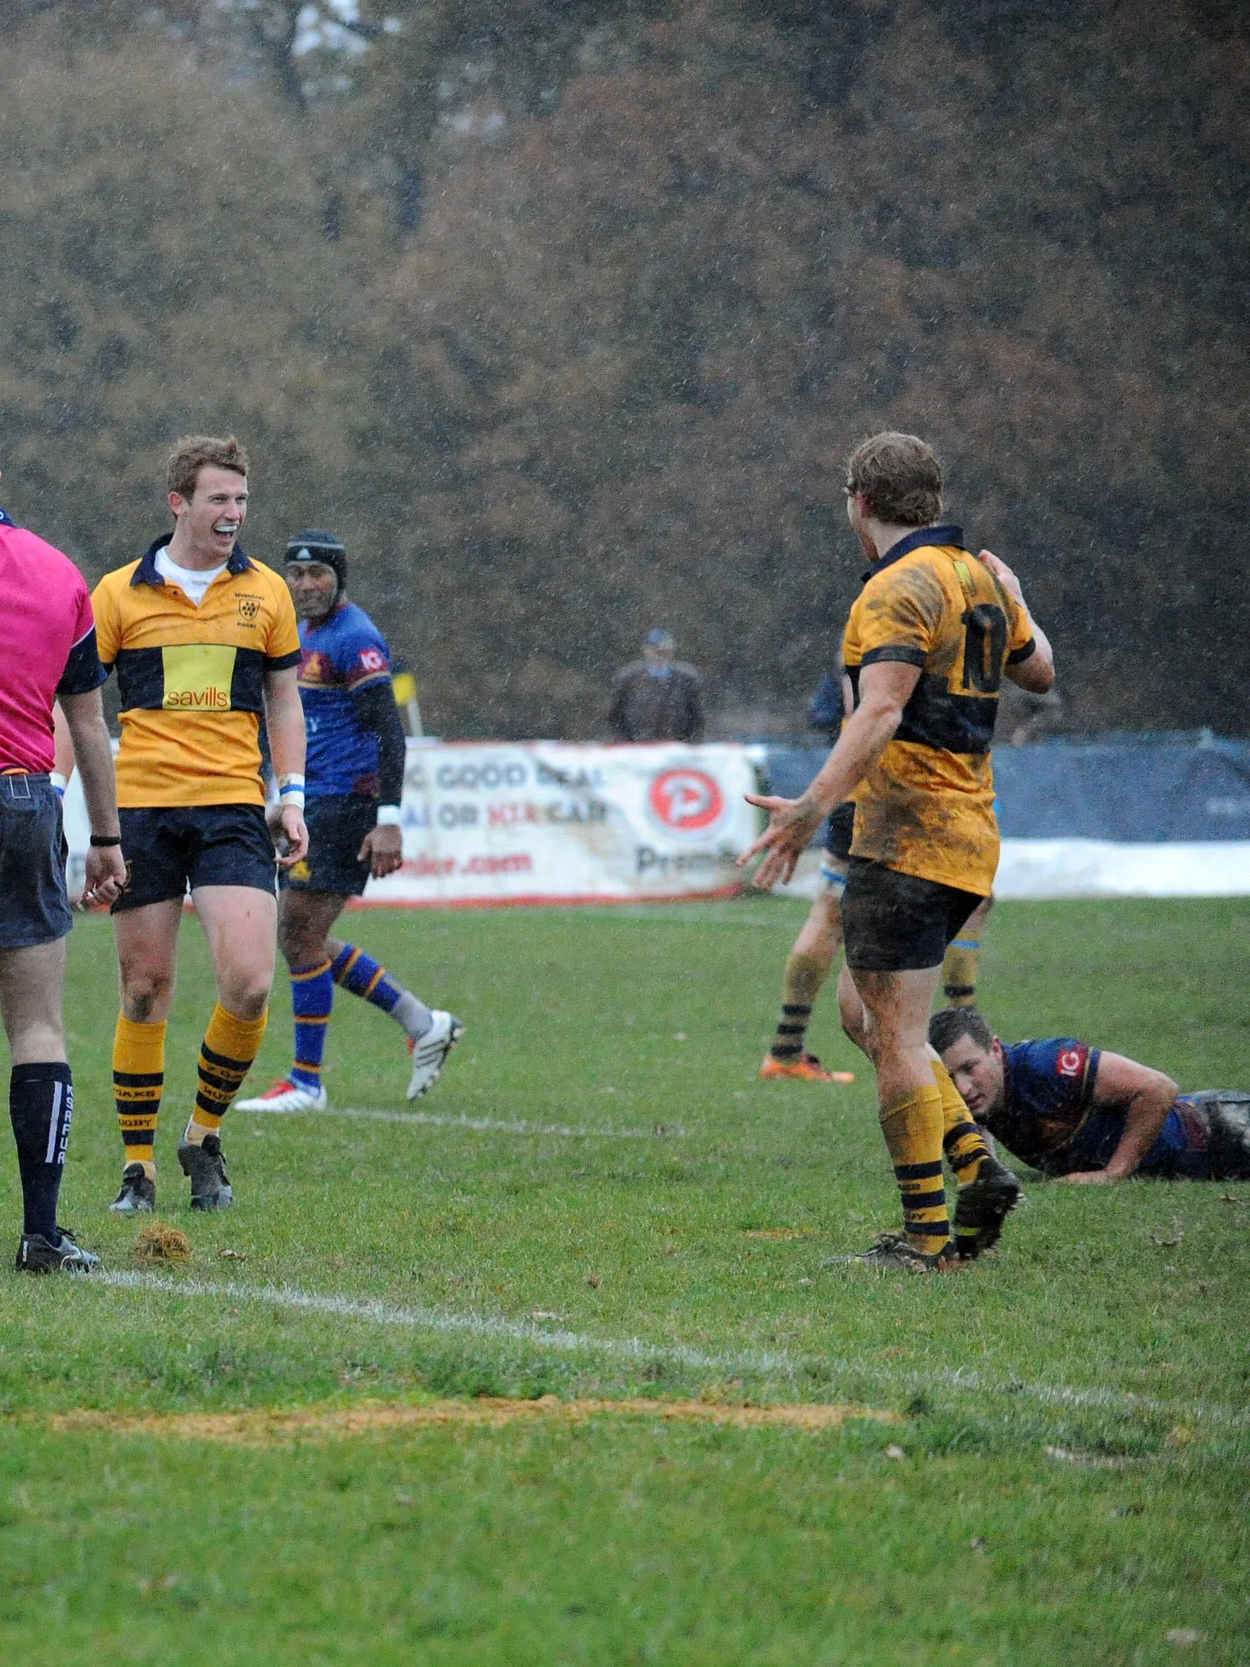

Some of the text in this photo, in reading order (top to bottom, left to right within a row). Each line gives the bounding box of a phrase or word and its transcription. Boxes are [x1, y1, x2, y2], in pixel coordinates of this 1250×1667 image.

[361, 651, 383, 670] IG
[961, 604, 1007, 692] 10
[166, 687, 228, 707] savills
[437, 763, 526, 790] GOOD
[1061, 1052, 1080, 1077] IG
